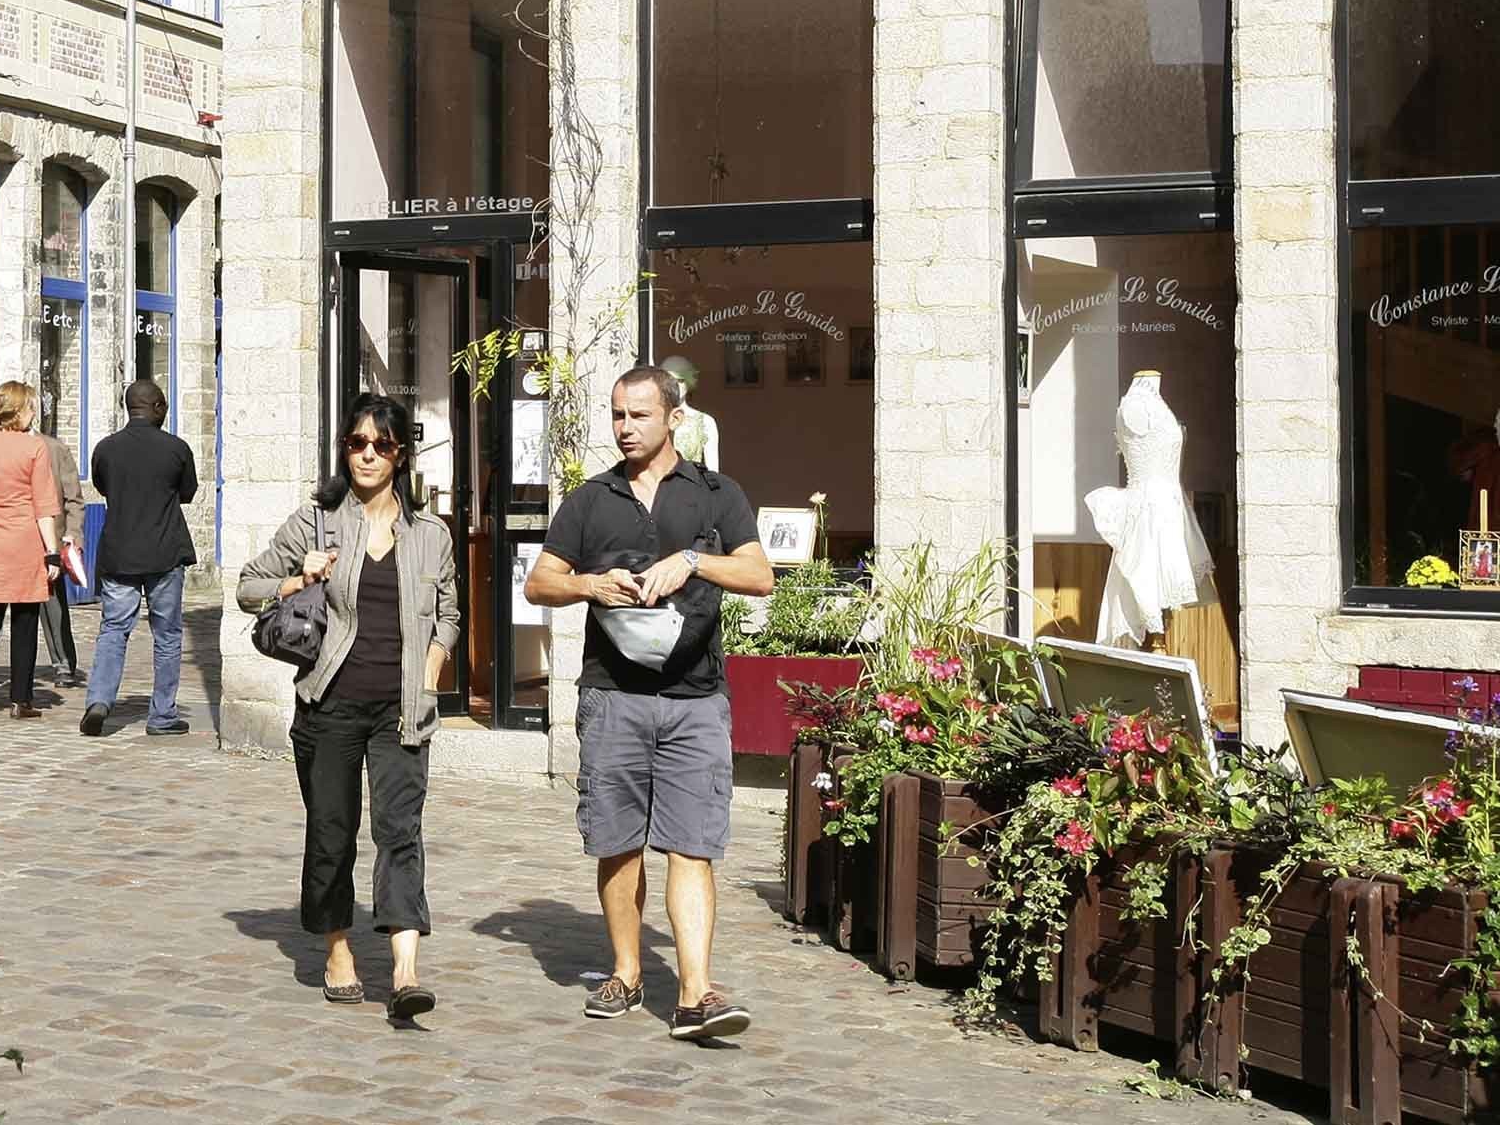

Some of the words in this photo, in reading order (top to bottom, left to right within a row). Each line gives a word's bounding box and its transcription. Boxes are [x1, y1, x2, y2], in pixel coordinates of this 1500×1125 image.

[446, 197, 458, 212] à
[465, 195, 533, 213] l'étage
[1370, 281, 1473, 327] Constance
[1478, 265, 1500, 293] L
[1026, 291, 1118, 335] Constance
[1120, 276, 1149, 303] Le
[1156, 277, 1225, 331] Gonidec
[669, 303, 749, 344] Constance
[753, 290, 779, 315] Le
[785, 291, 845, 342] Gonidec
[1431, 314, 1469, 327] Styliste
[762, 331, 807, 342] Confection
[1132, 322, 1176, 333] Mariées
